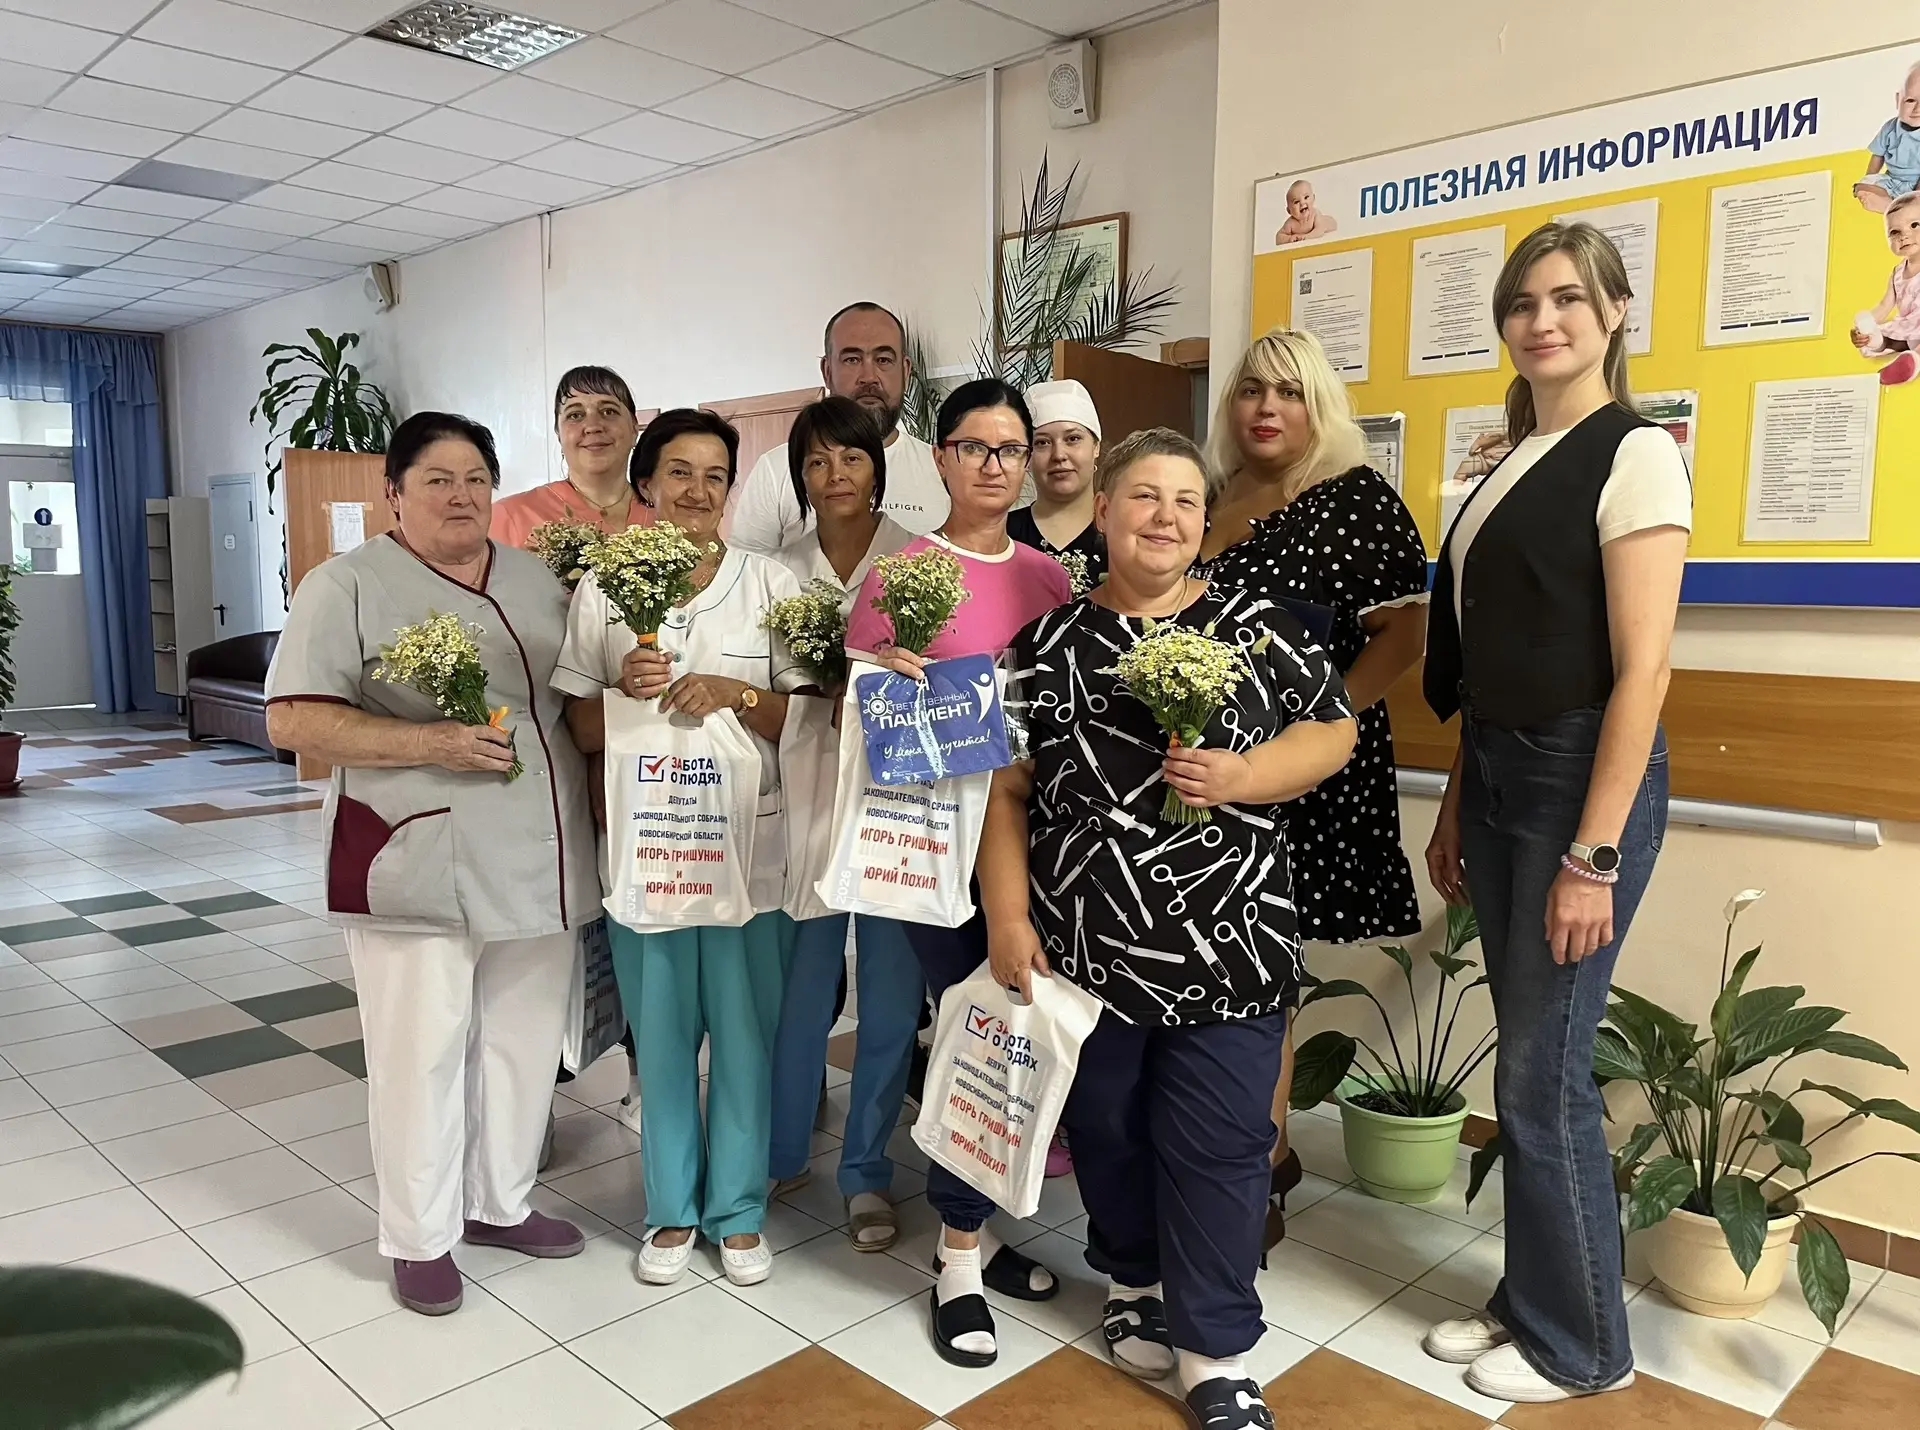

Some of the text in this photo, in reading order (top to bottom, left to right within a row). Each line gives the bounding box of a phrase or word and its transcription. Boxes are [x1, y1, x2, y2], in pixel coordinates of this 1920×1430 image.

[1359, 97, 1819, 218] ПОЛЕЗНАЯ ИНФОРМАЦИЯ
[671, 757, 715, 772] ЗАБОТА
[670, 771, 722, 786] О ЛЮДЯХ
[668, 795, 697, 806] ДЕПУТАТЫ
[633, 812, 696, 824] ЗАКОНОДАТЕЛЬНОГО
[865, 806, 925, 826] НОВОСИБИРСКОЙ
[639, 829, 724, 841] НОВОСИБИРСКОЙ ОБЛАСТИ
[860, 826, 895, 845] ИГОРЬ
[636, 846, 724, 862] ИГОРЬ ГРИШУНИН
[863, 866, 899, 886] ЮРИЙ
[900, 872, 937, 891] ПОХИЛ
[646, 880, 712, 896] ЮРИЙ ПОХИЛ
[992, 1034, 1001, 1047] О
[995, 1020, 1032, 1053] ЗАОТА
[986, 1056, 1008, 1076] ДЕПУТА
[949, 1092, 977, 1119] ИГОРЬ
[950, 1129, 976, 1156] ЮРИЙ
[976, 1148, 1007, 1177] ПОХИЛ
